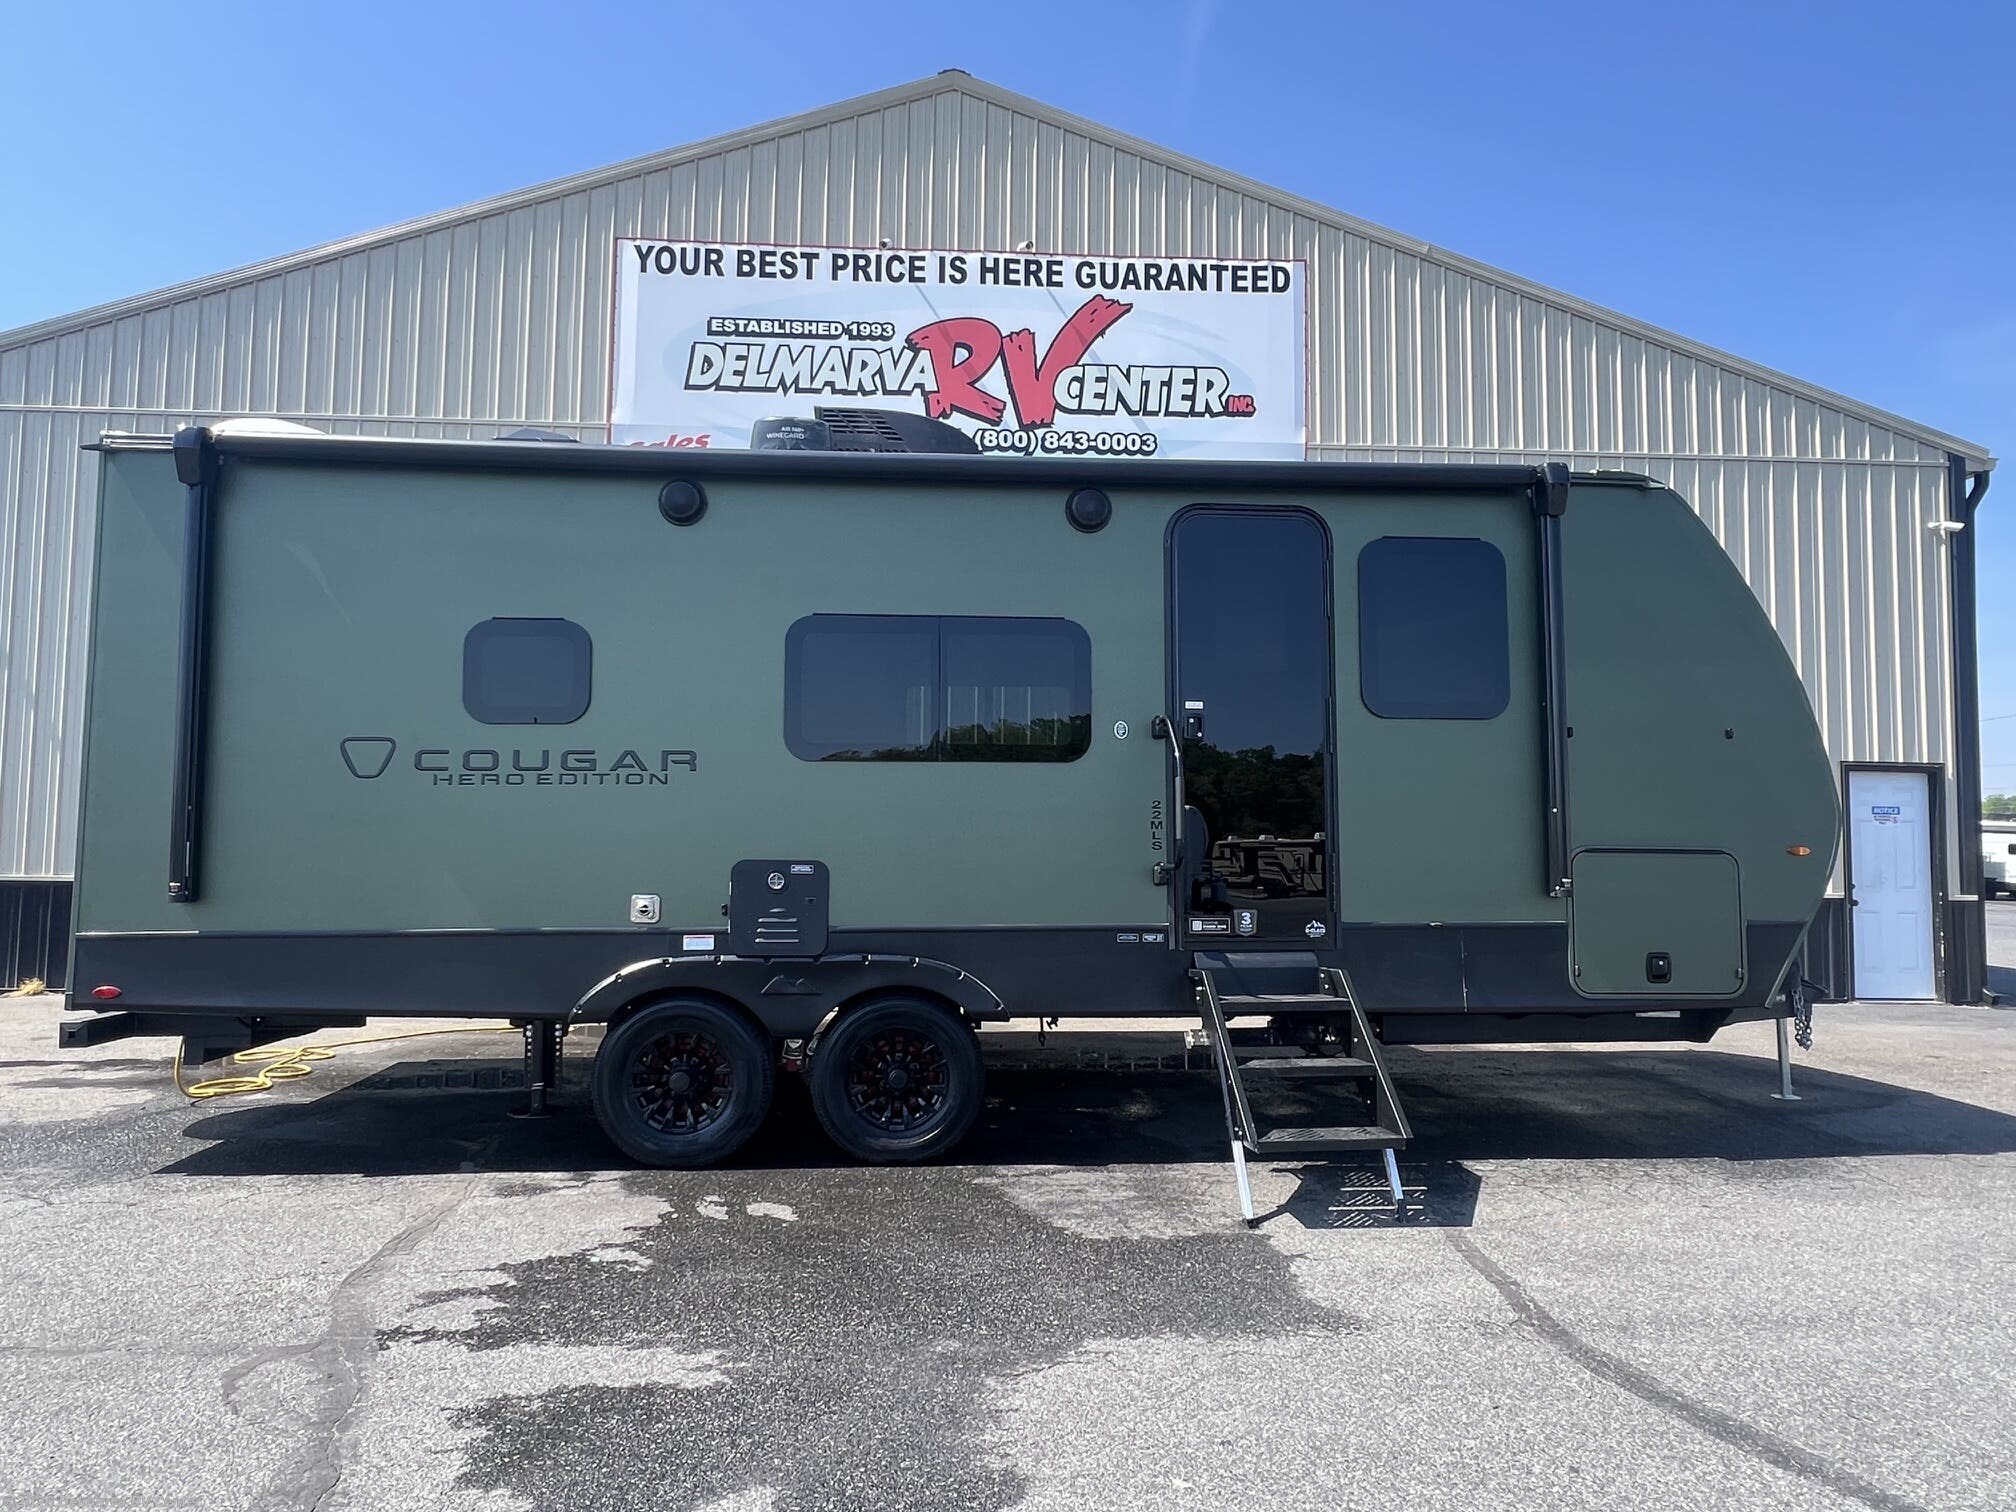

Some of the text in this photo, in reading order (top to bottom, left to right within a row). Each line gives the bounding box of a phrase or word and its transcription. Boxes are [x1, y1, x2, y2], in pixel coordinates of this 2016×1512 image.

[634, 244, 1292, 293] YOUR BEST PRICE IS HERE GUARANTEED
[709, 317, 895, 339] ESTABLISHED 1993
[685, 294, 1256, 429] DELMARVA RV CENTER INC.
[765, 432, 806, 440] WINEGARD
[975, 429, 1157, 454] (800) 843-0003
[413, 749, 698, 772] COUGAR
[433, 772, 669, 787] HERO EDITION
[1150, 800, 1164, 851] 22MLS
